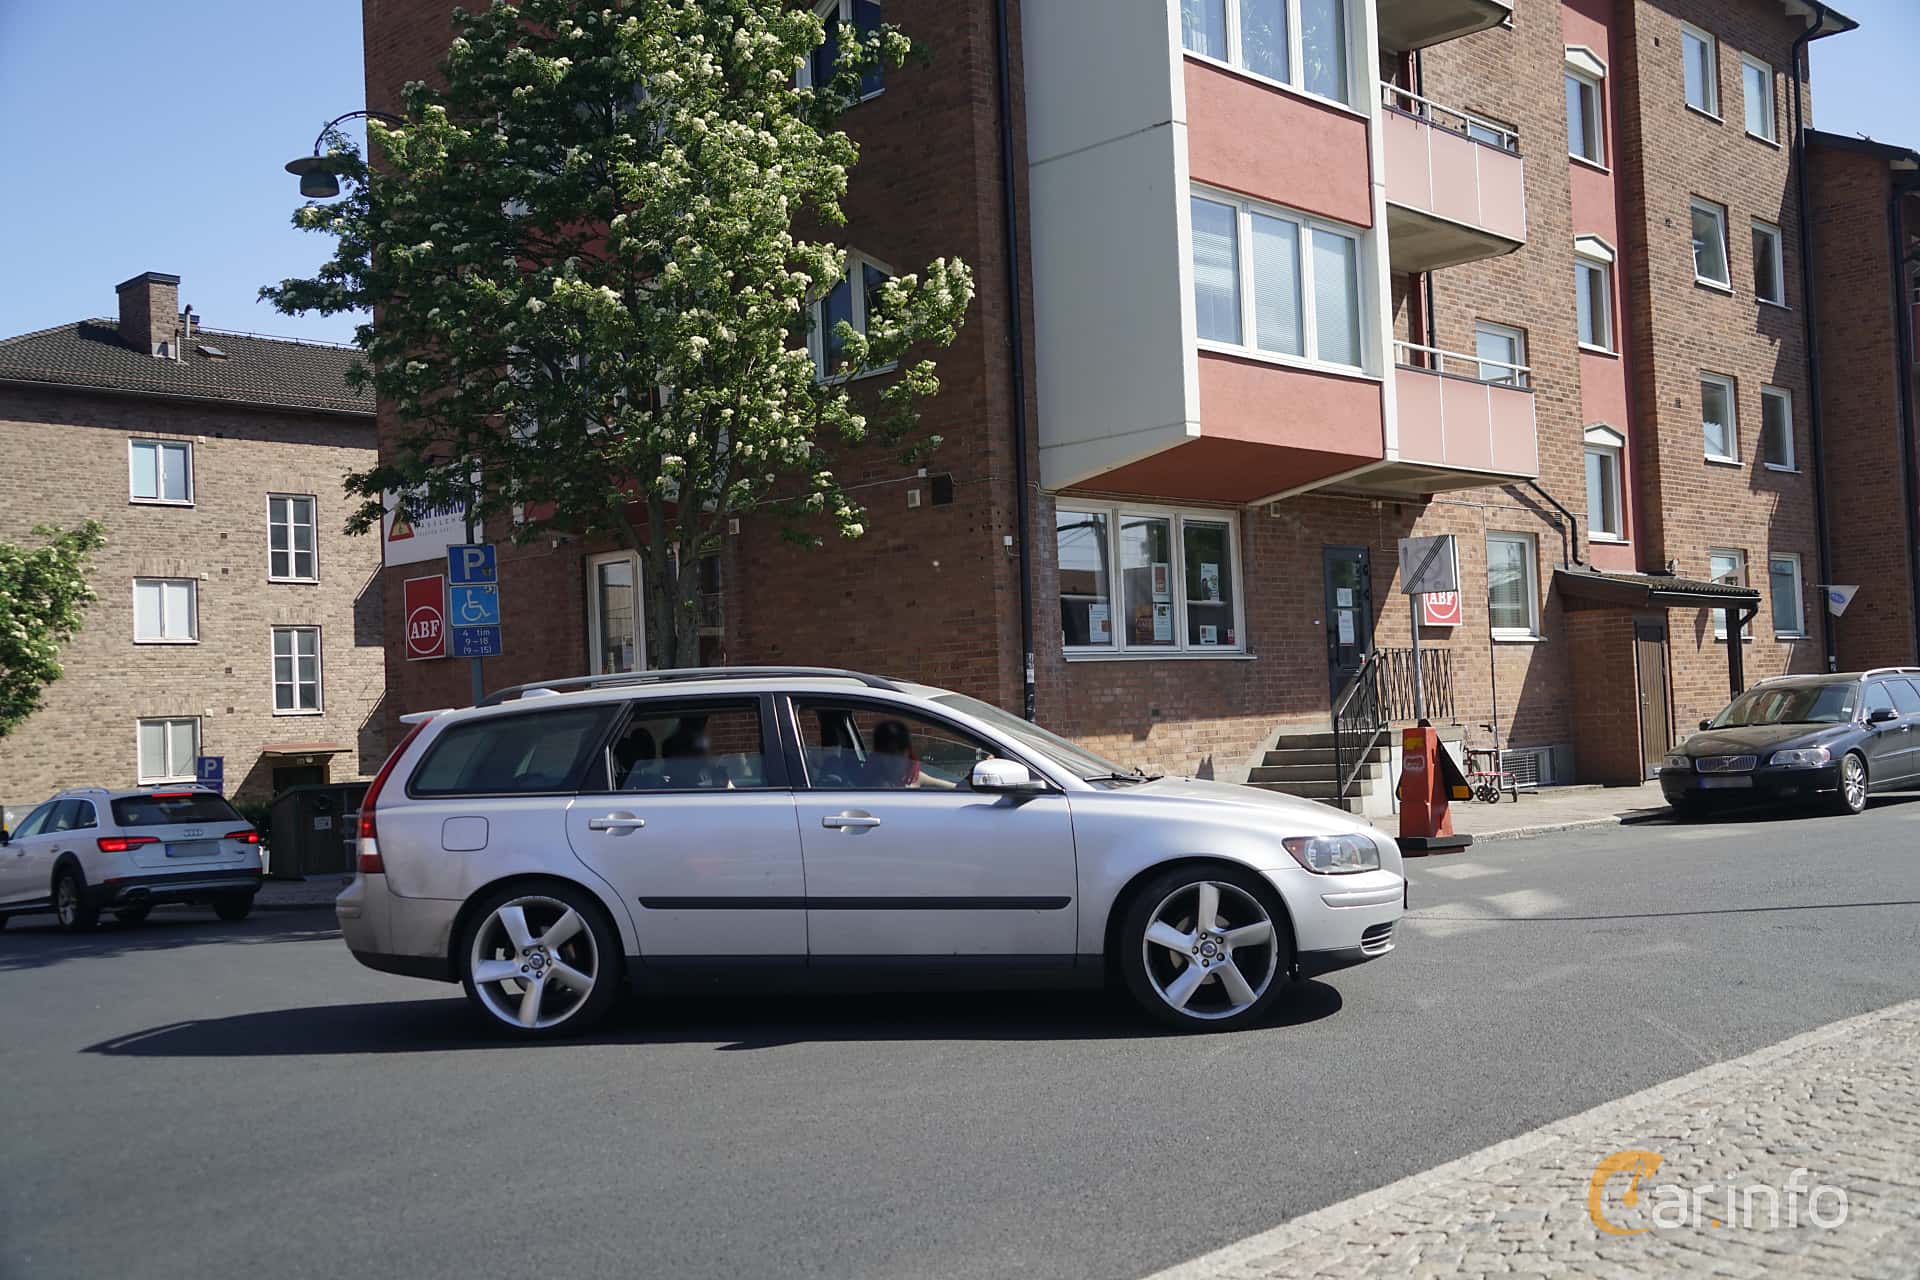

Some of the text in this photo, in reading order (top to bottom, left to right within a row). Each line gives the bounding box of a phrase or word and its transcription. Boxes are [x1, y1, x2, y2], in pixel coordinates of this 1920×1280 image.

[463, 548, 485, 580] P
[410, 619, 440, 640] ABF
[476, 628, 490, 637] tim
[204, 759, 217, 778] P
